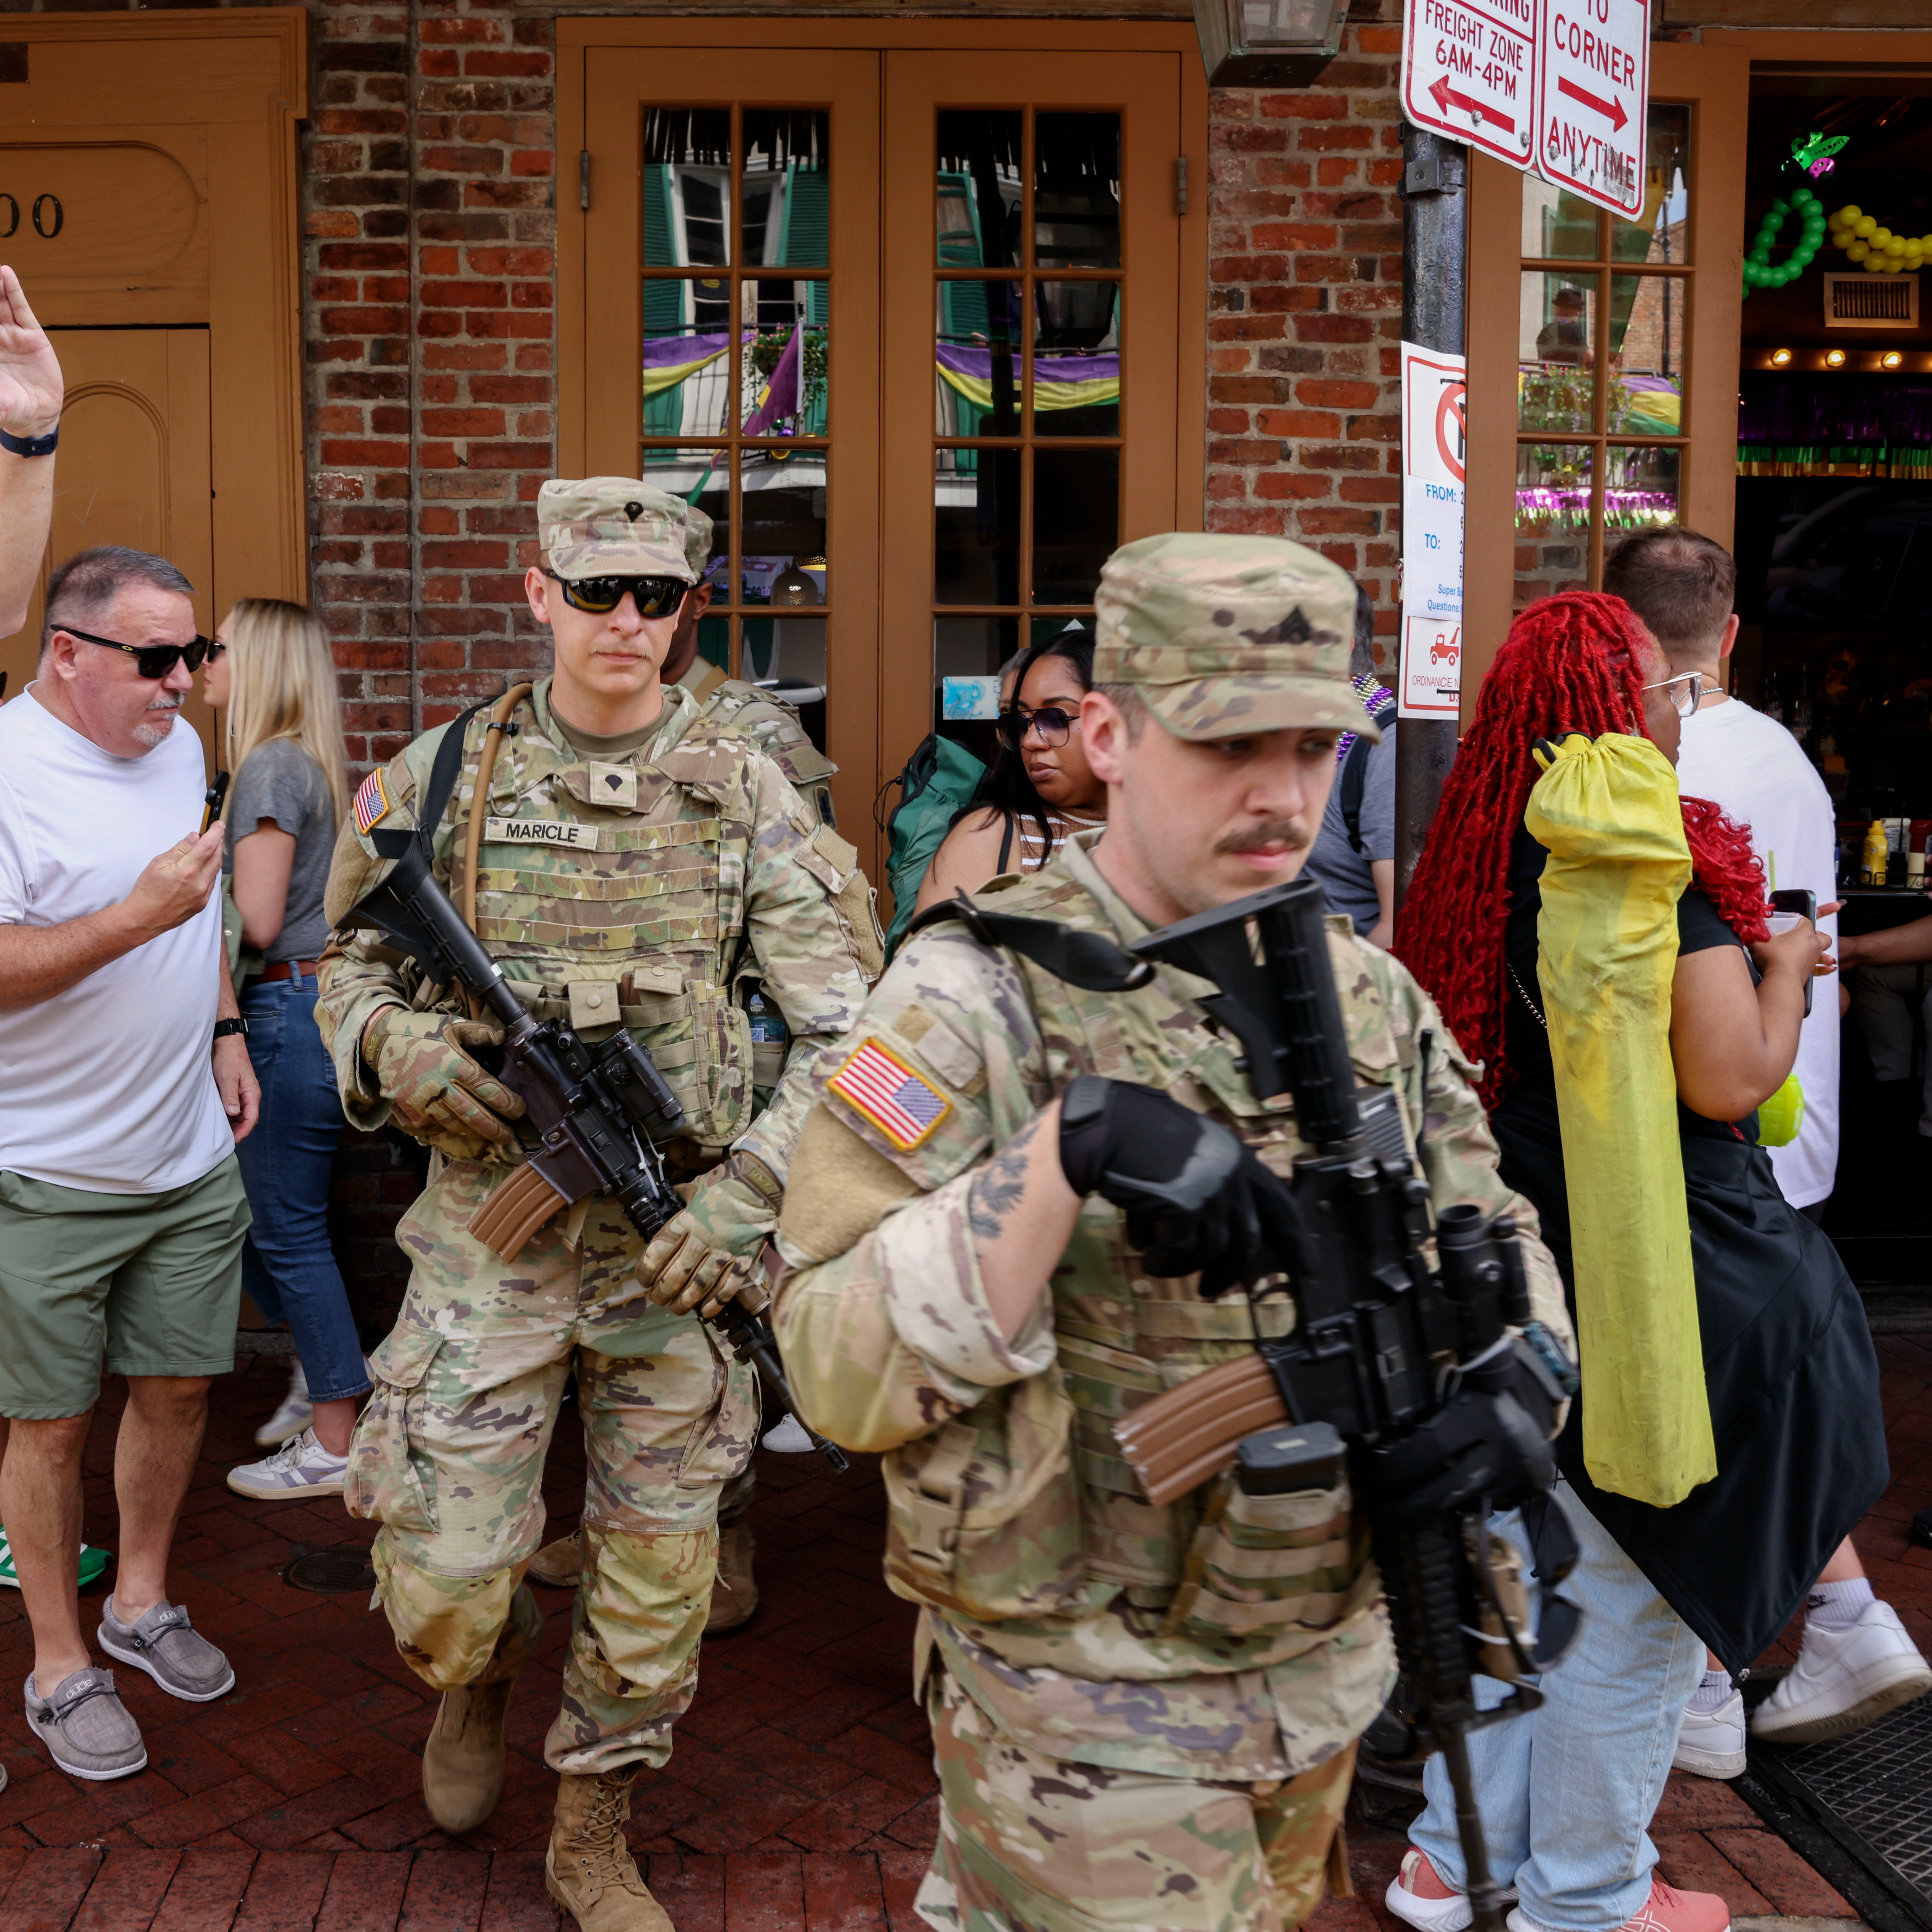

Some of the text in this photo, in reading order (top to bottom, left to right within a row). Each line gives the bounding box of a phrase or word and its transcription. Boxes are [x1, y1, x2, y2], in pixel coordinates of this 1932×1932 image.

[1426, 0, 1484, 50] FREIGHT
[1490, 30, 1523, 72] ZONE
[1555, 13, 1635, 91] CORNER
[1436, 39, 1516, 100] 6AM-4PM
[1547, 116, 1636, 192] ANYTIME
[1426, 484, 1456, 502] FROM:
[1425, 533, 1441, 550] TO:
[1438, 584, 1456, 597] Super
[1427, 599, 1460, 613] Questions:
[1412, 675, 1453, 687] ORDINANCE
[506, 823, 579, 843] MARICLE
[66, 1679, 93, 1699] dude
